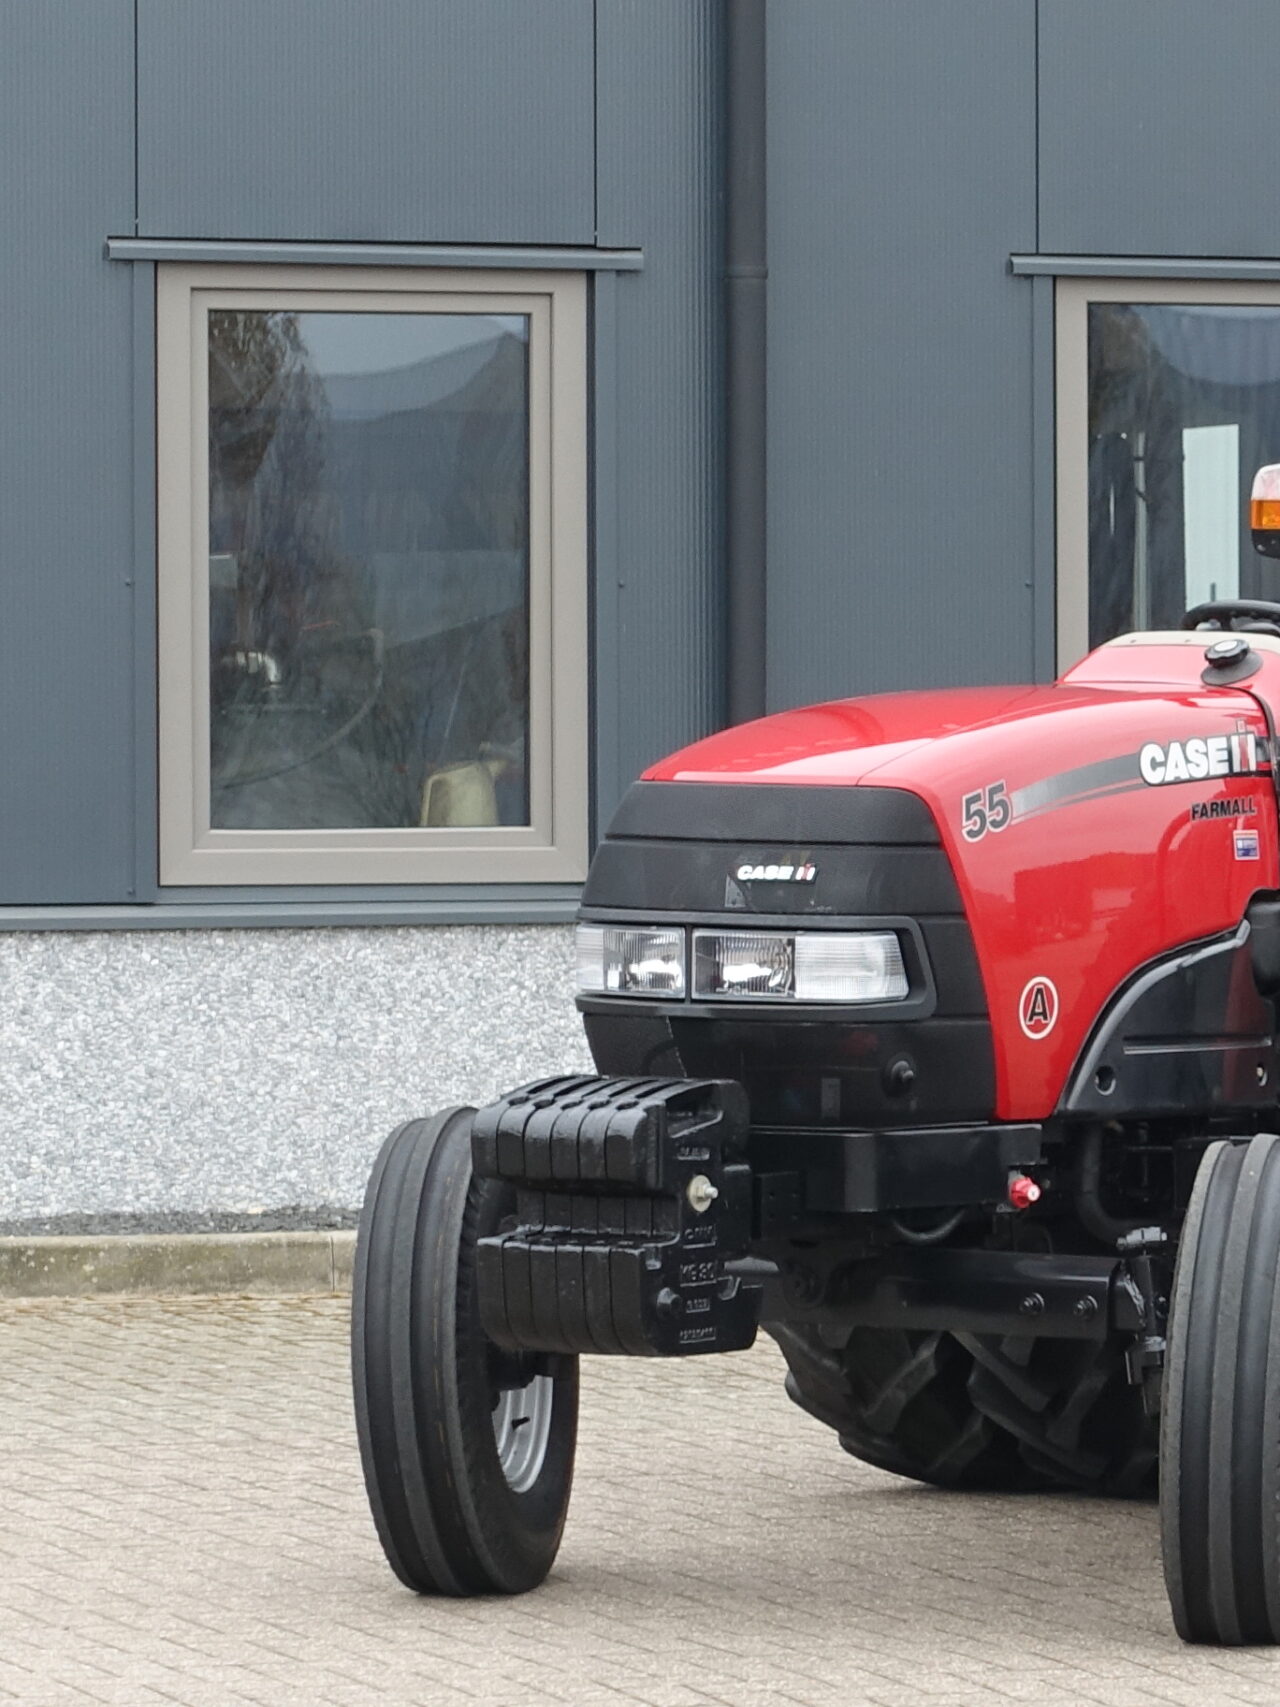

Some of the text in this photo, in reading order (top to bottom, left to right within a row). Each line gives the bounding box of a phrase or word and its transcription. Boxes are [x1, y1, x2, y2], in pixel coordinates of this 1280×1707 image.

[1140, 736, 1230, 786] CASE
[962, 780, 1011, 842] 55
[1191, 798, 1256, 821] FARMALL
[737, 864, 794, 881] CASE
[1026, 985, 1050, 1025] A
